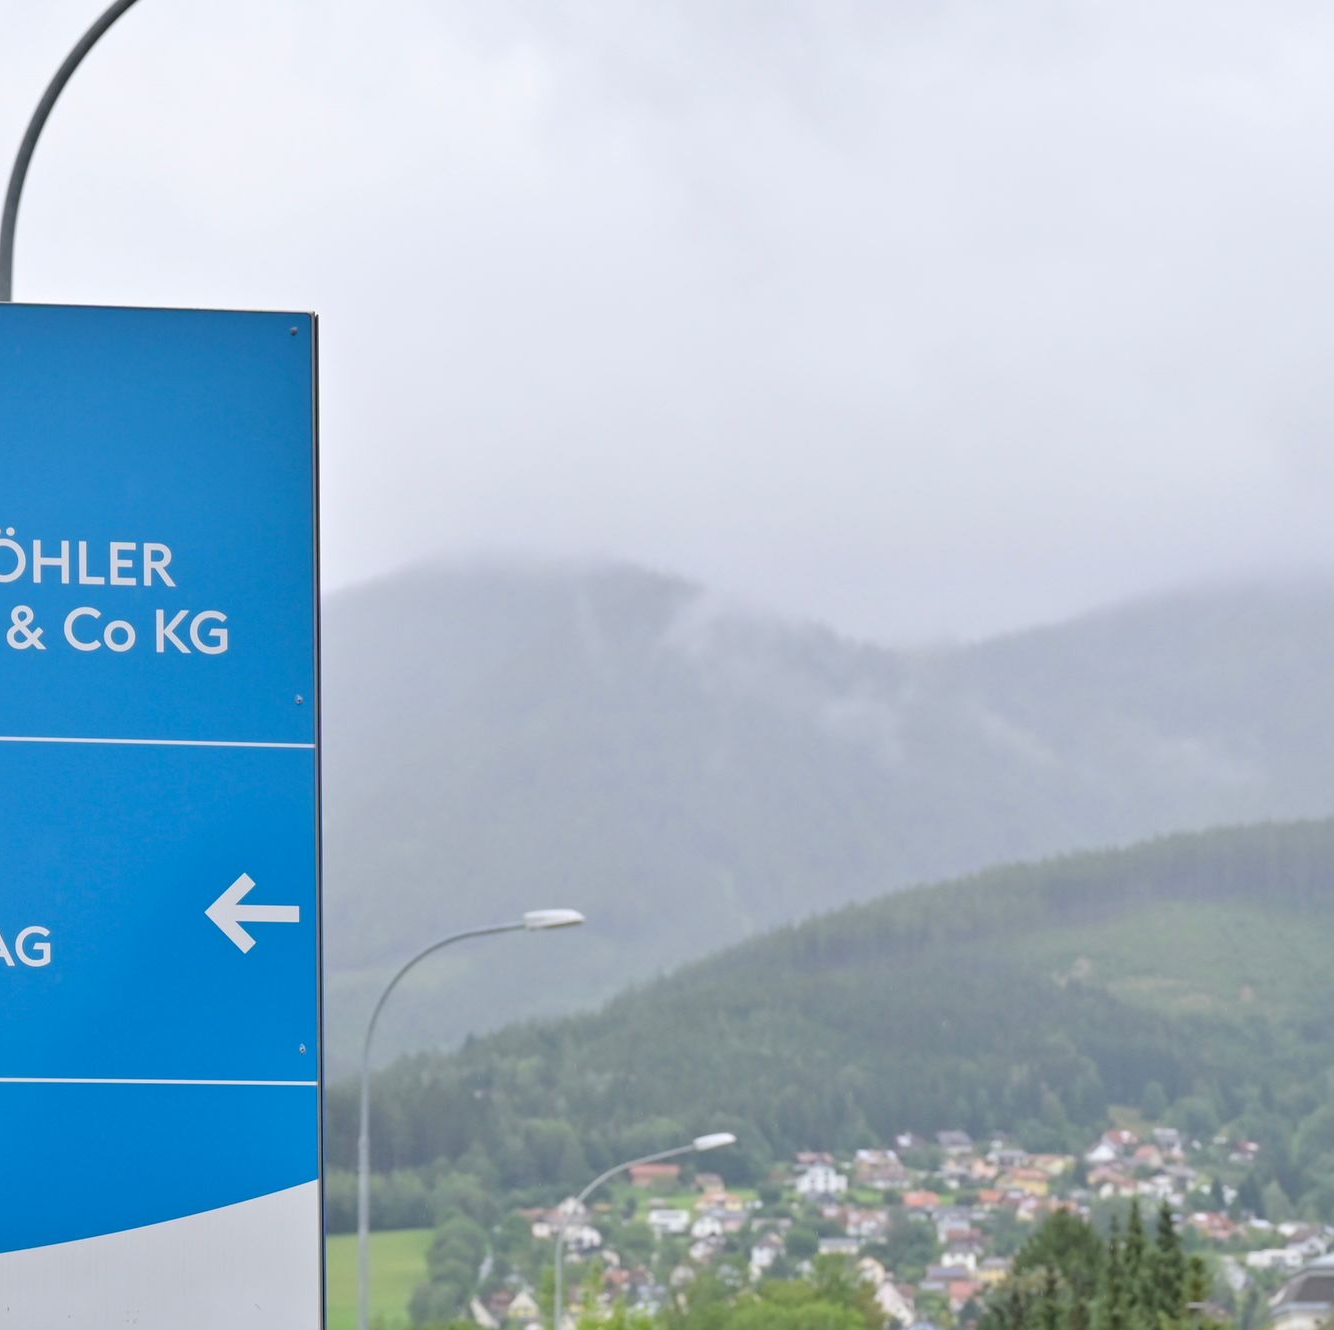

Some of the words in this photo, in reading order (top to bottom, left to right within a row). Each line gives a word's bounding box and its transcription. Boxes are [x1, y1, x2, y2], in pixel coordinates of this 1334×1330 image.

[6, 604, 47, 650] &
[63, 606, 137, 653] Co
[155, 608, 230, 656] KG
